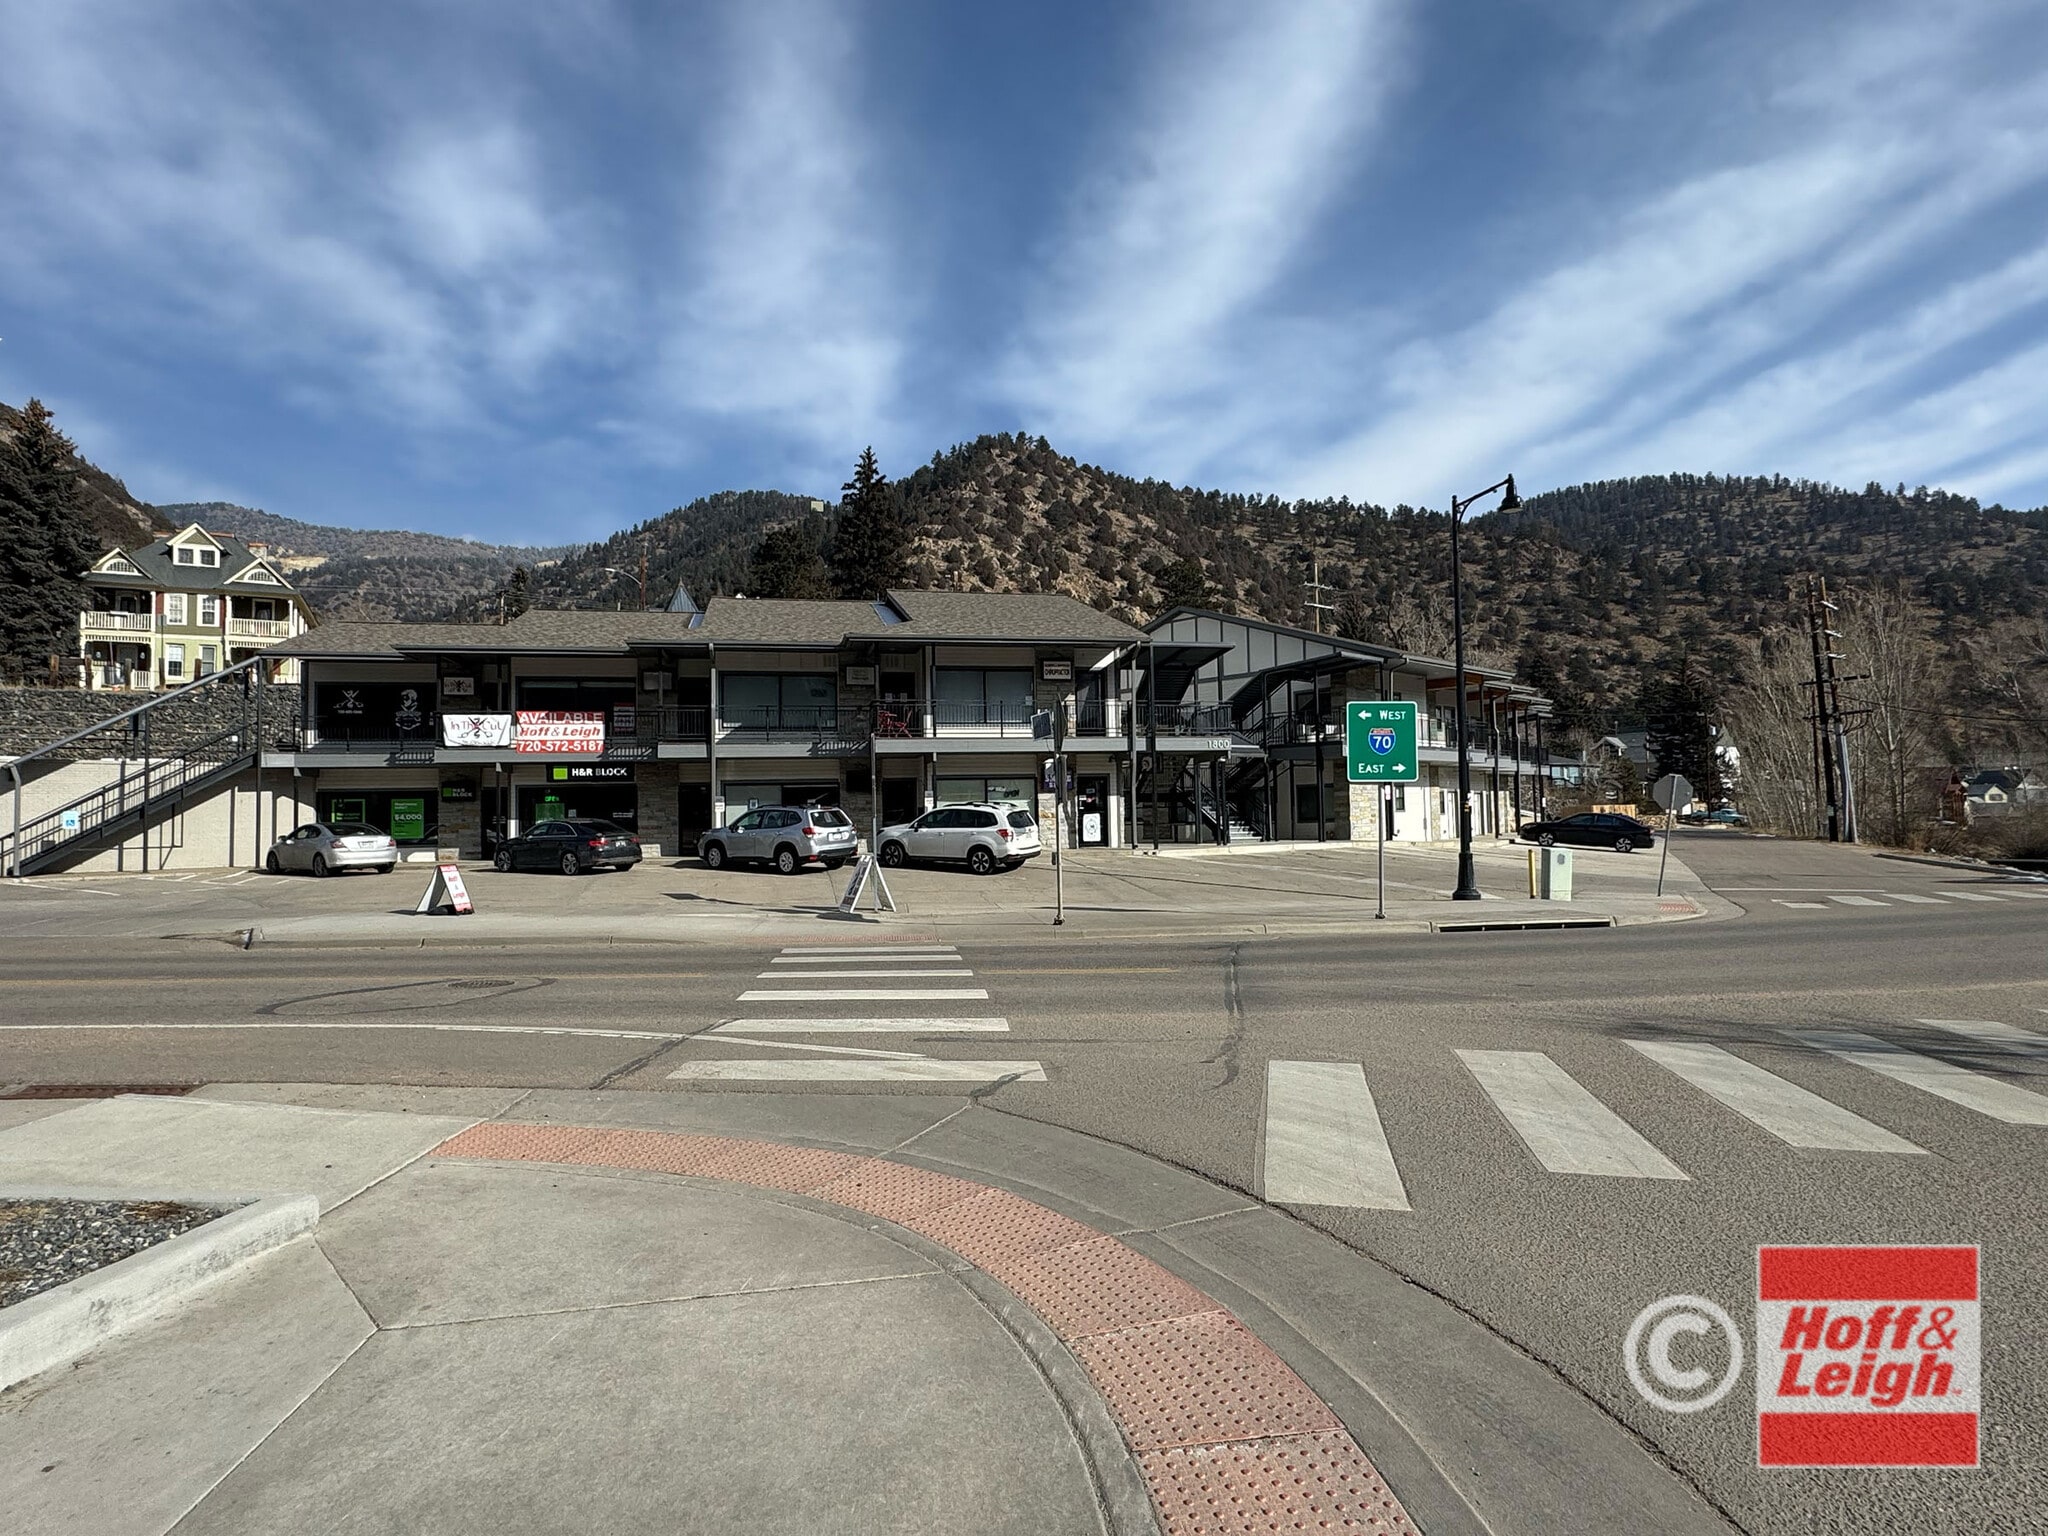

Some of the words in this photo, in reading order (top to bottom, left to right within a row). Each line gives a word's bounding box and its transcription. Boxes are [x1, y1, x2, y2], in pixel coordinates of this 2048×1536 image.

[519, 712, 602, 724] AVAILABLE
[1379, 709, 1406, 720] WEST
[519, 726, 551, 738] Hoff
[551, 727, 560, 737] &
[562, 726, 601, 739] Leigh
[519, 740, 602, 751] 720-572-5187
[1207, 739, 1230, 749] 1800
[1373, 736, 1392, 749] 70
[571, 767, 593, 777] H&R
[595, 767, 627, 777] BLOCK
[1358, 763, 1384, 773] EAST
